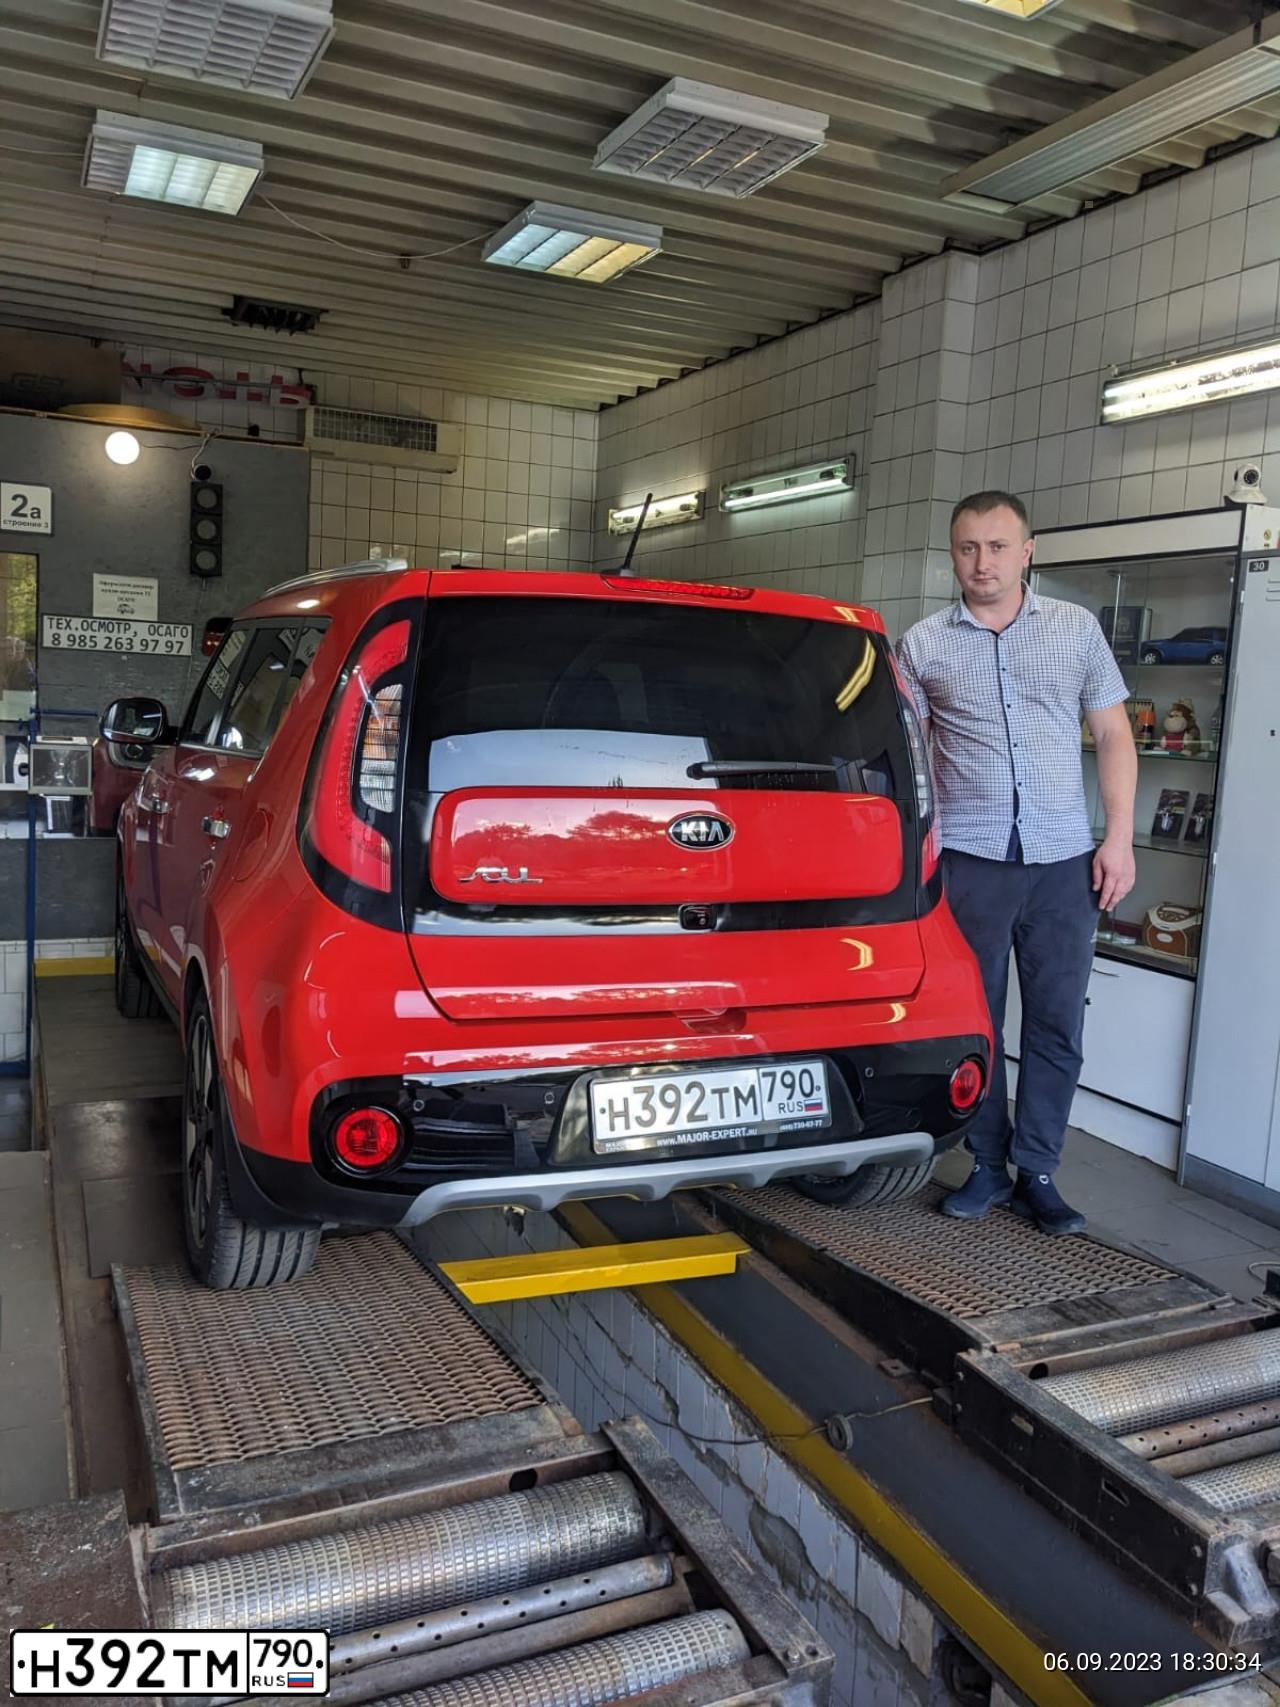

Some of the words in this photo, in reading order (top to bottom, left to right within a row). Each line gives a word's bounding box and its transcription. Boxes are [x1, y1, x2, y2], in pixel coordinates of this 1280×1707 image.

[147, 623, 189, 638] ОСАГО
[51, 632, 61, 647] 8
[66, 633, 98, 649] 985
[103, 636, 134, 651] 263
[139, 638, 160, 652] 97
[164, 640, 184, 654] 97
[680, 821, 725, 842] KIA
[761, 1068, 815, 1103] 790
[778, 1100, 804, 1115] RUS
